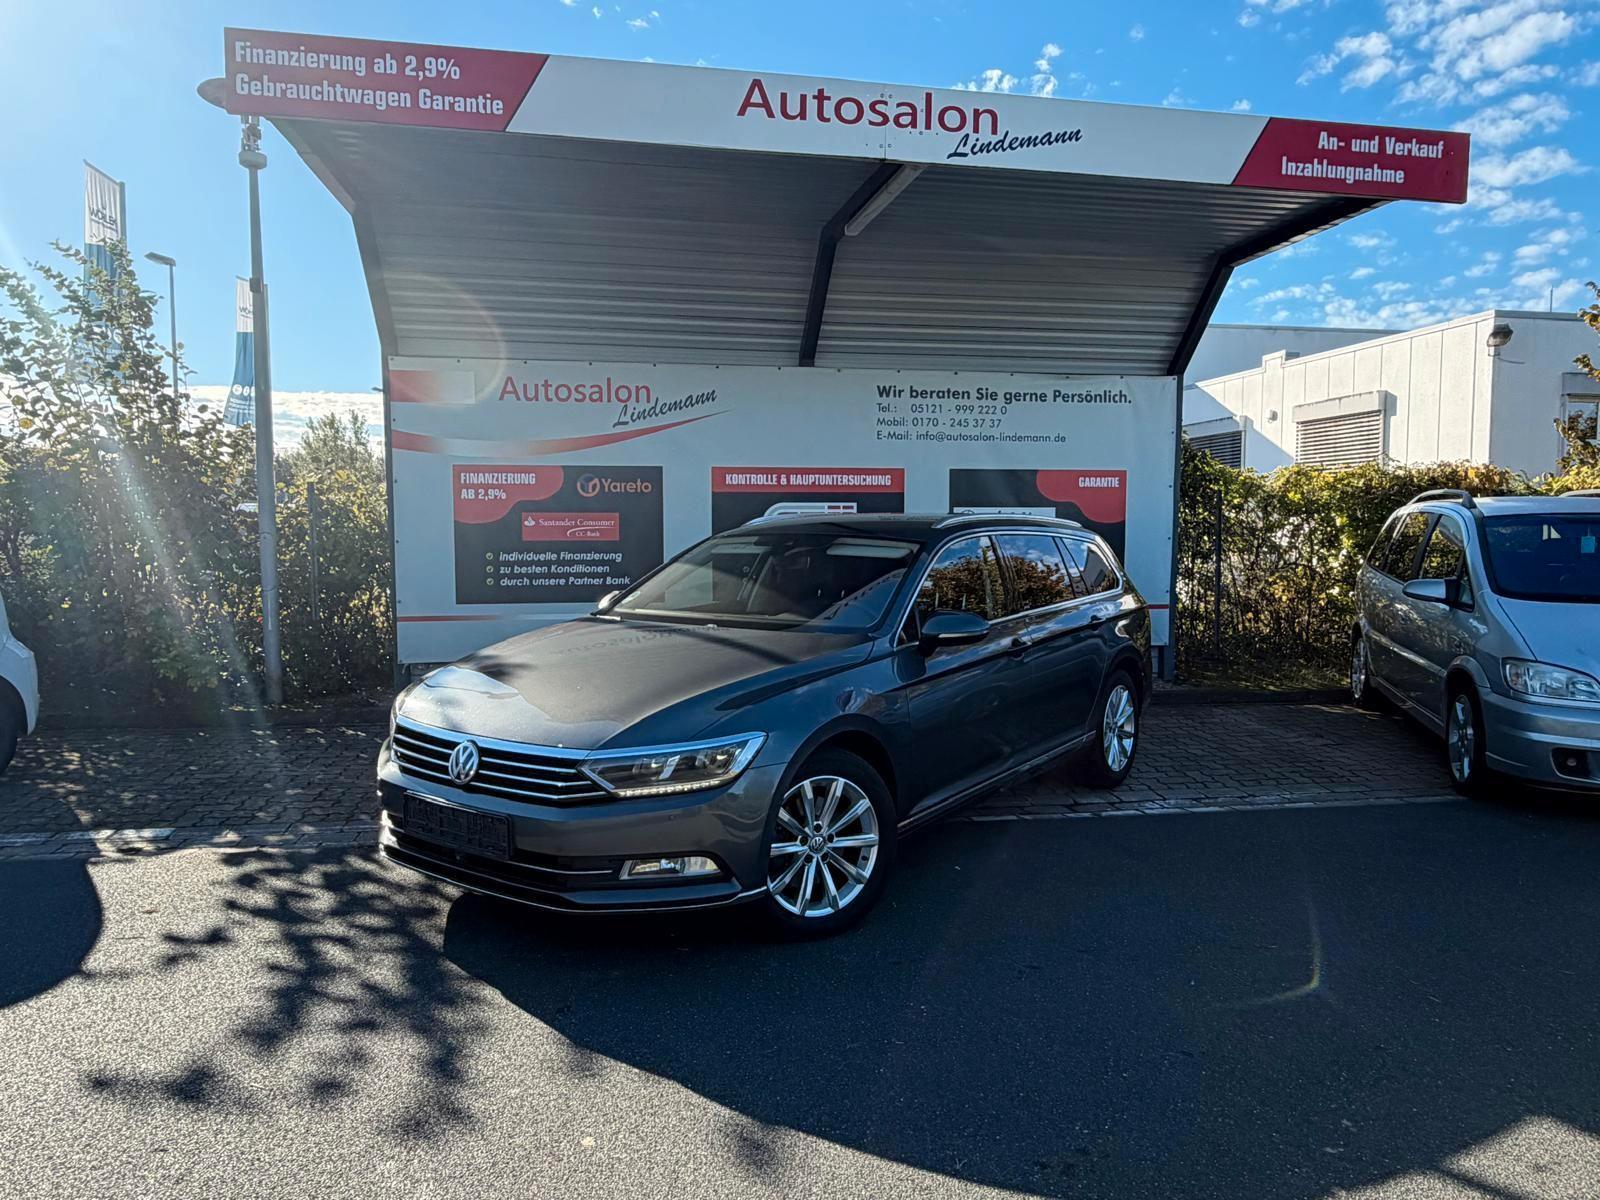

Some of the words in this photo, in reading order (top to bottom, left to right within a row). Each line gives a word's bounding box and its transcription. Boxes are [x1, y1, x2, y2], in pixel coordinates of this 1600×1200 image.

[235, 41, 366, 76] Finanzierung
[373, 55, 397, 75] ab
[404, 56, 460, 81] 2,9%
[235, 73, 411, 111] Gebrauchtwagen
[418, 88, 504, 115] Garantie
[737, 78, 999, 136] Autosalon
[947, 128, 1083, 160] Lindemann
[1318, 131, 1345, 150] An-
[1351, 135, 1379, 154] und
[1385, 136, 1445, 159] Verkauf
[1281, 156, 1405, 184] Inzahlungnahme
[498, 376, 652, 404] Autosalon
[876, 385, 904, 399] Wir
[909, 385, 971, 400] beraten
[976, 387, 998, 401] Sie
[1003, 390, 1048, 405] gerne
[1052, 389, 1132, 404] Persönlich.
[613, 389, 718, 428] Lindemann
[876, 403, 897, 414] Tel.:
[911, 403, 943, 414] 05121
[955, 404, 975, 415] 999
[978, 404, 998, 415] 222
[1000, 405, 1008, 415] 0
[876, 417, 909, 427] Mobil:
[912, 417, 939, 428] 0170
[950, 417, 970, 428] 245
[972, 418, 986, 428] 37
[989, 418, 1002, 429] 37
[876, 431, 913, 441] E-Mail:
[915, 431, 1067, 443] info@autosalon-lindemann.de
[460, 472, 537, 485] FINANZIERUNG
[725, 473, 778, 485] KONTROLLE
[780, 474, 788, 486] &
[790, 474, 892, 486] HAUPTUNTERSUCHUNG
[1078, 477, 1120, 488] GARANTIE
[601, 478, 652, 493] Yareto
[460, 488, 475, 500] AB
[478, 488, 507, 501] 2,9%
[538, 518, 576, 527] Santander
[577, 518, 616, 527] Consumer
[499, 551, 558, 561] individuelle
[560, 551, 623, 563] Finanzierung
[499, 565, 511, 574] zu
[513, 563, 548, 574] besten
[550, 564, 610, 574] Konditionen
[500, 576, 530, 587] durch
[532, 577, 566, 586] unsere
[568, 576, 604, 586] Partner
[606, 576, 631, 586] Bank
